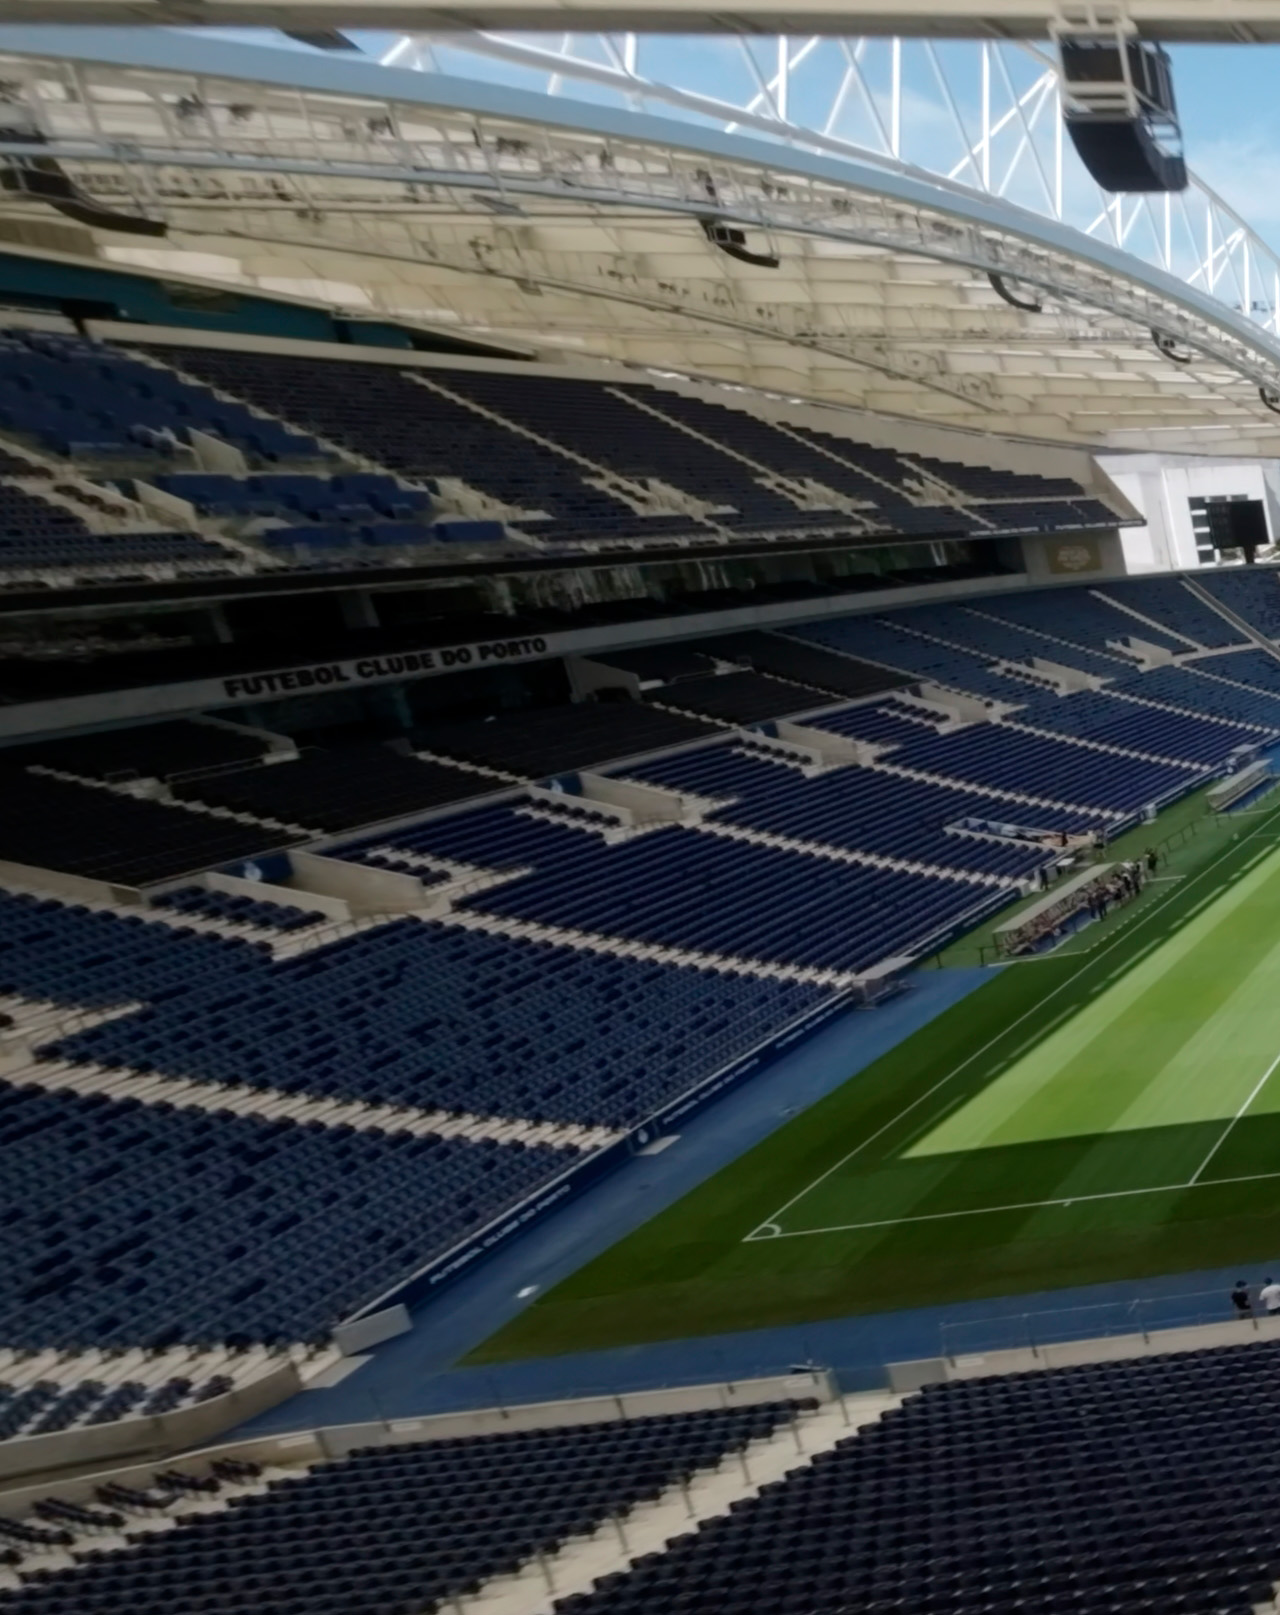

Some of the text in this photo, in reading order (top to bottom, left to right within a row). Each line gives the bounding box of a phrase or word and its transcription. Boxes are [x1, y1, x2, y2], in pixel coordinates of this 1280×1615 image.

[222, 637, 548, 699] FUTEBOL CLUBE DO PORTO
